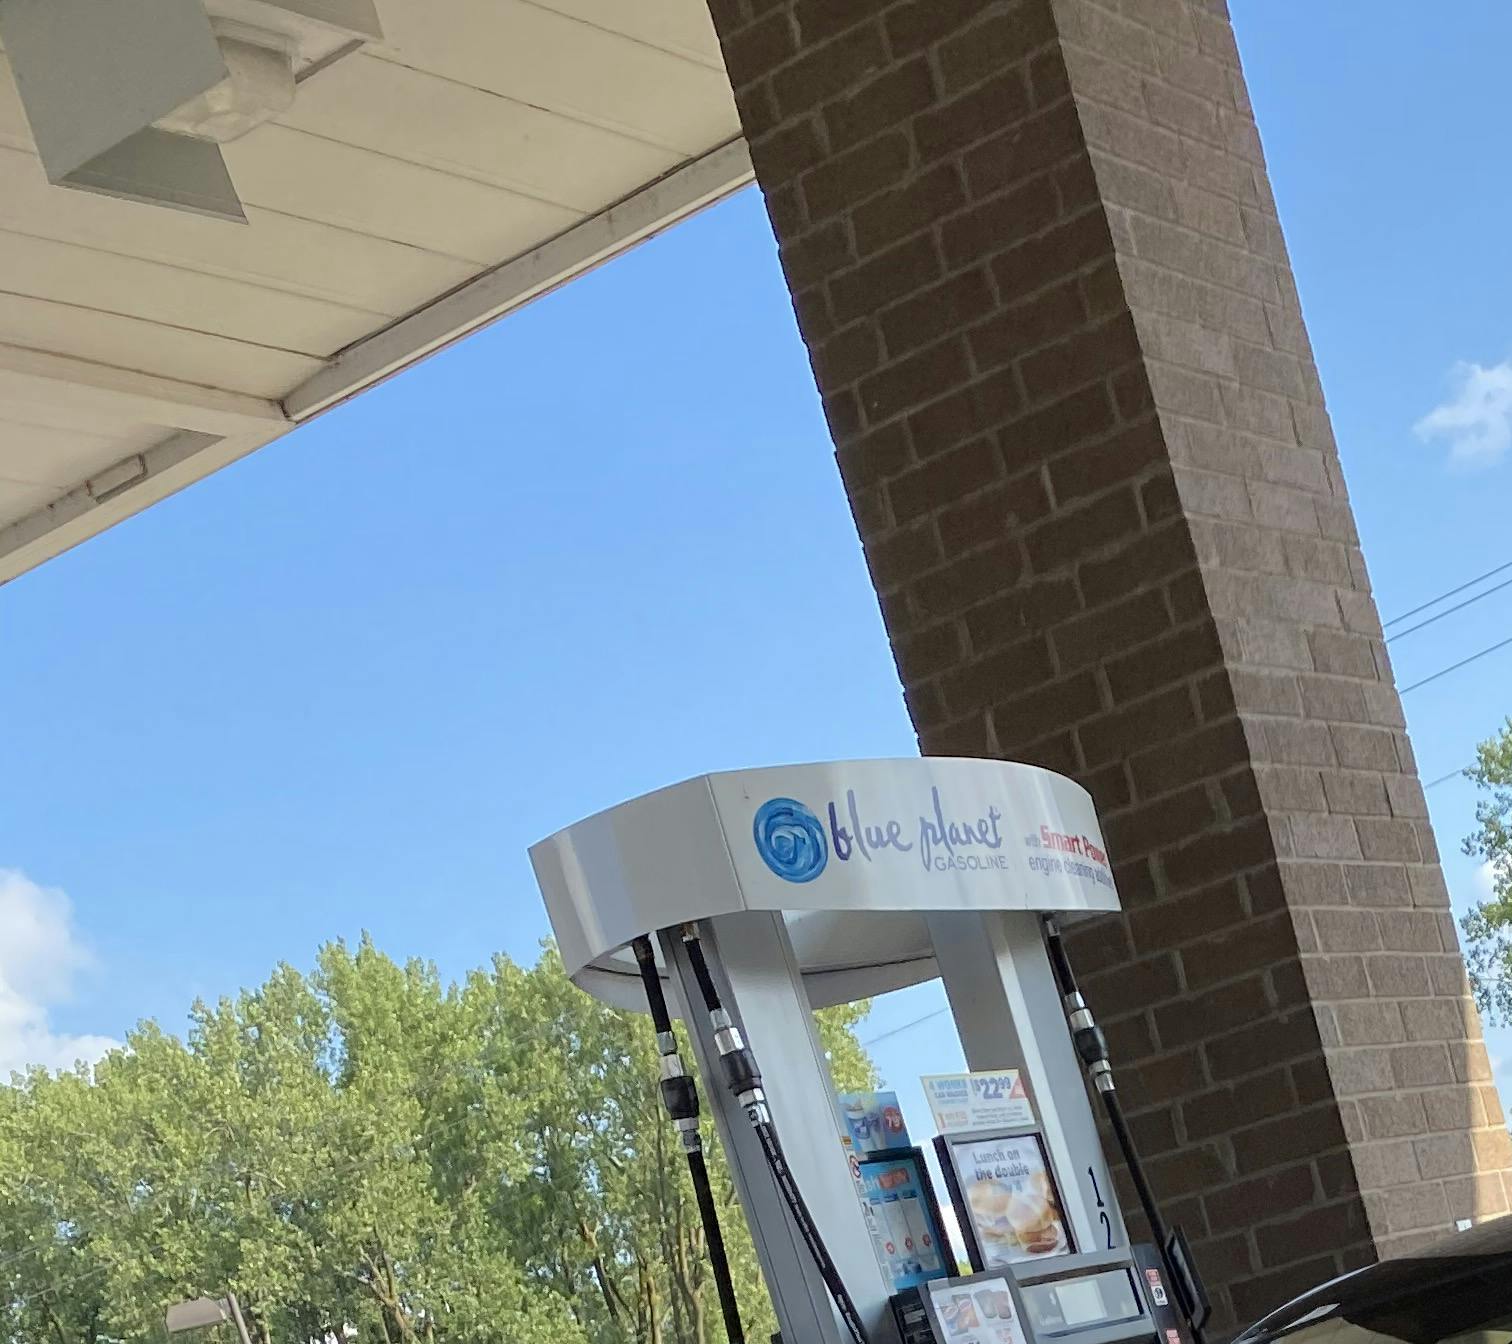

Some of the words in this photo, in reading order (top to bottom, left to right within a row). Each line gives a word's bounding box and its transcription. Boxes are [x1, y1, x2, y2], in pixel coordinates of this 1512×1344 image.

[828, 789, 912, 862] blue
[920, 786, 1001, 872] planet
[1040, 825, 1083, 855] Smart
[934, 855, 1010, 872] GASOLINE
[1028, 856, 1063, 877] engine
[972, 1149, 1006, 1164] Lunch
[1007, 1149, 1021, 1159] on
[975, 1166, 993, 1181] the
[995, 1163, 1030, 1179] double
[1088, 1166, 1105, 1207] 1
[1101, 1212, 1117, 1250] 2
